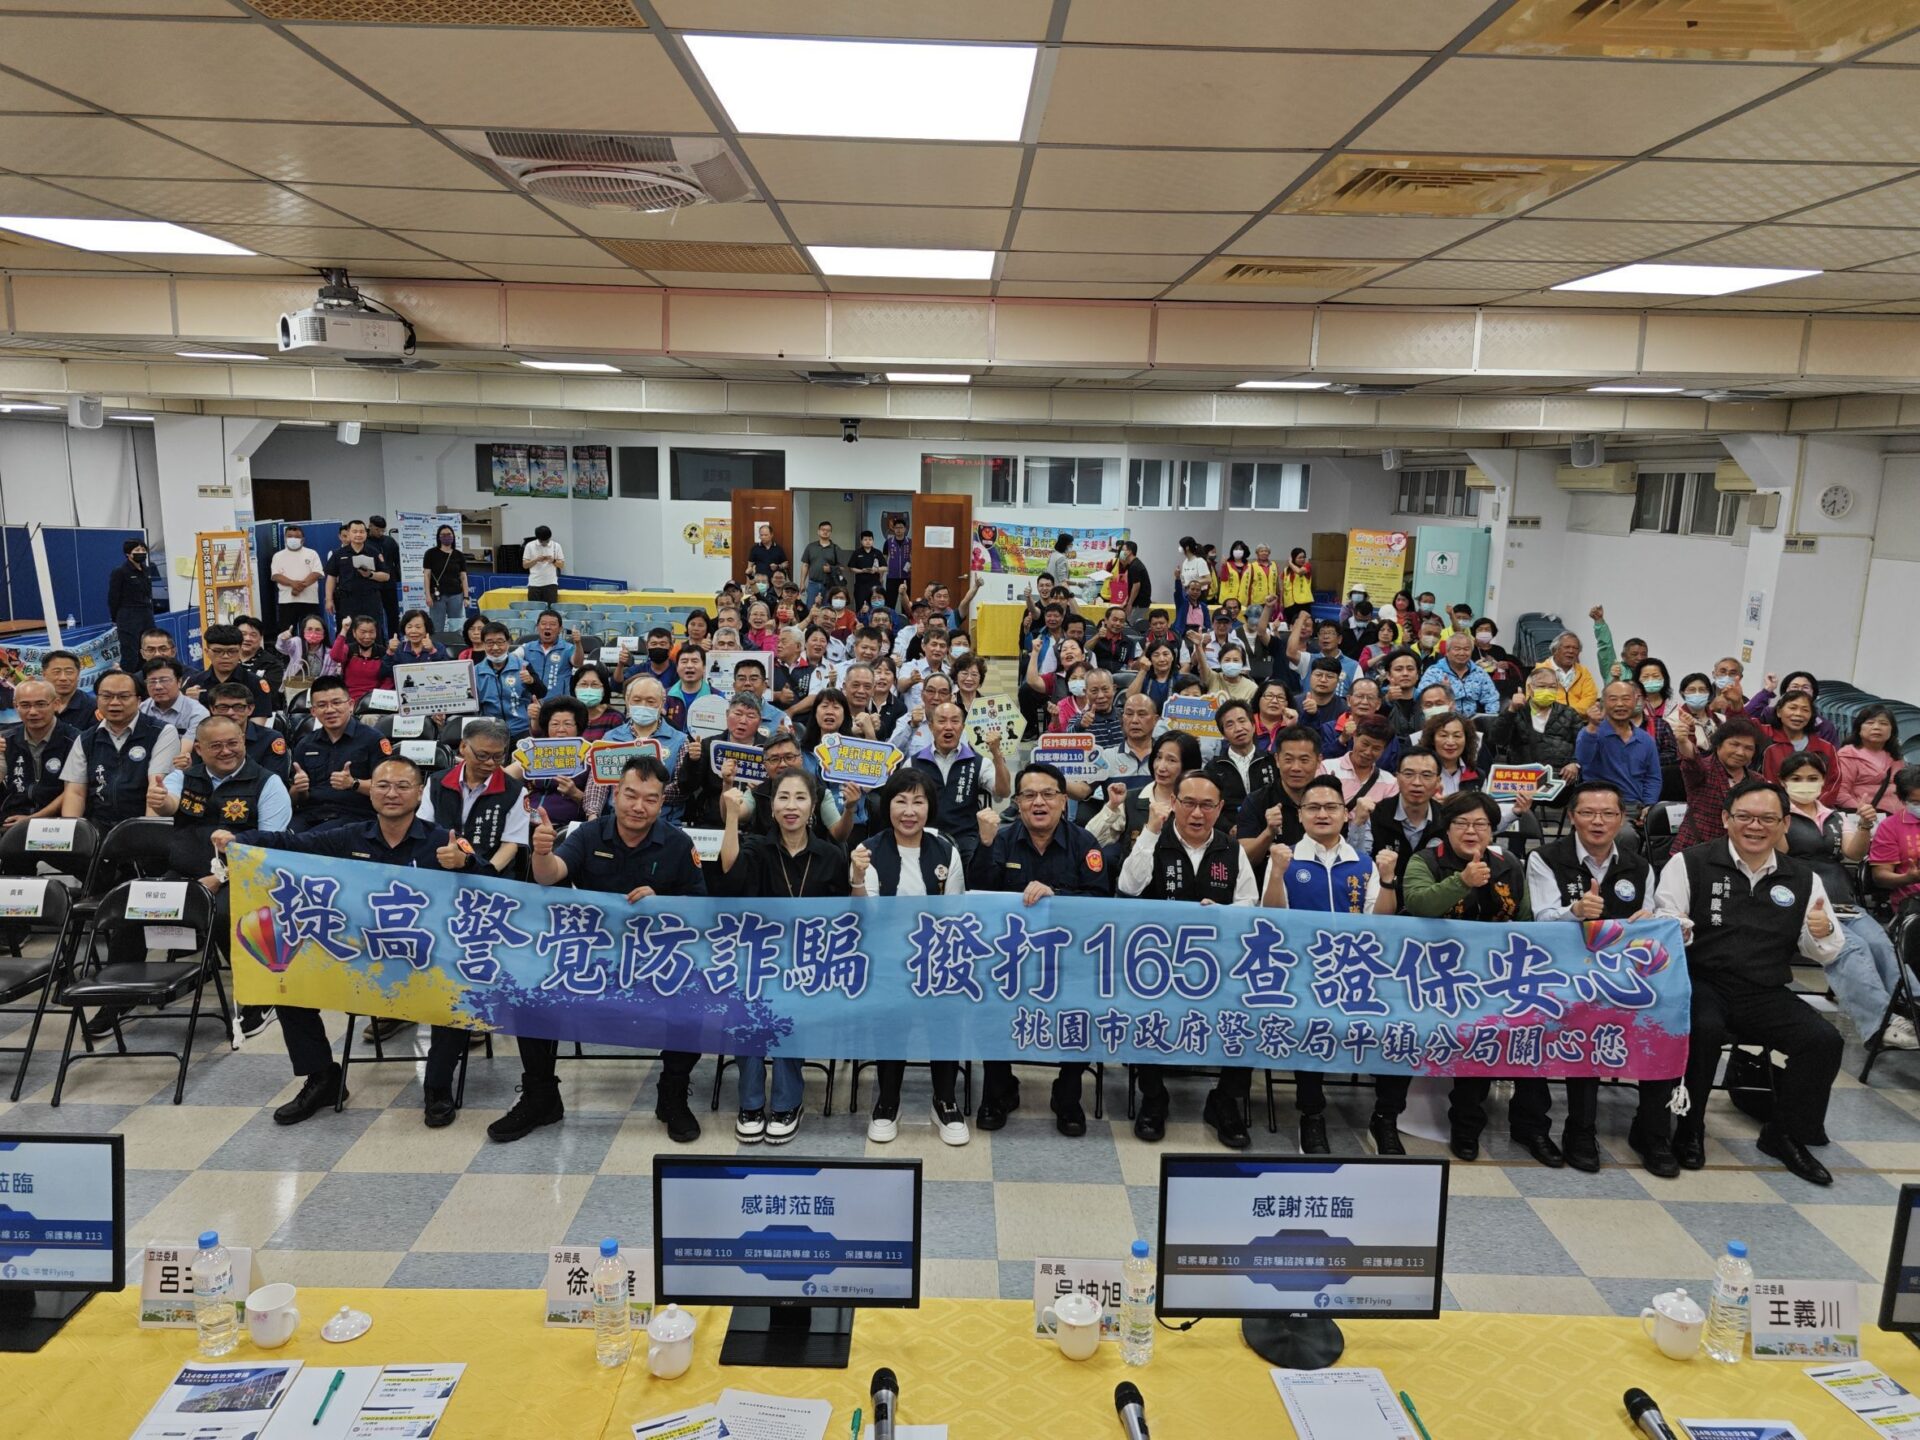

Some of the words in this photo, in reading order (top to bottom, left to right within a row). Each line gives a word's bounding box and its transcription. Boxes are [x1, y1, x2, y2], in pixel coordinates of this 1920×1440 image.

[1167, 704, 1213, 717] 性騷擾不得了
[1042, 738, 1092, 748] 反詐專線165
[837, 745, 886, 763] 視訊裸聊
[1035, 752, 1084, 763] 報案專線110
[834, 758, 882, 777] 真心騙照
[1495, 770, 1536, 780] 帳戶當人頭
[268, 867, 871, 1001] 提高警覺防詐騙
[905, 911, 1657, 1018] 撥打165查證保安心
[1012, 1006, 1628, 1067] 桃園市政府警察局平鎮分局關心您
[741, 1194, 836, 1216] 感謝蒞臨
[1252, 1195, 1355, 1219] 感謝蒞臨
[13, 1231, 30, 1239] 165
[44, 1231, 82, 1240] 保護專線
[85, 1232, 102, 1240] 113
[148, 1251, 178, 1262] 立法委員
[555, 1252, 581, 1264] 分局長
[674, 1247, 712, 1258] 報案專線
[715, 1249, 732, 1258] 110
[744, 1248, 811, 1259] 反詐騙諮詢專線
[813, 1250, 831, 1259] 165
[845, 1250, 883, 1260] 保護專線
[886, 1251, 902, 1260] 113
[1177, 1255, 1219, 1266] 報案專線
[1221, 1256, 1240, 1265] 110
[1253, 1256, 1325, 1267] 反詐騙諮詢專線
[1328, 1257, 1346, 1267] 165
[1362, 1257, 1403, 1267] 保護專線
[1406, 1257, 1425, 1267] 113
[1040, 1263, 1066, 1276] 局長
[1755, 1285, 1785, 1295] 立法委員
[1769, 1299, 1840, 1328] 王義川
